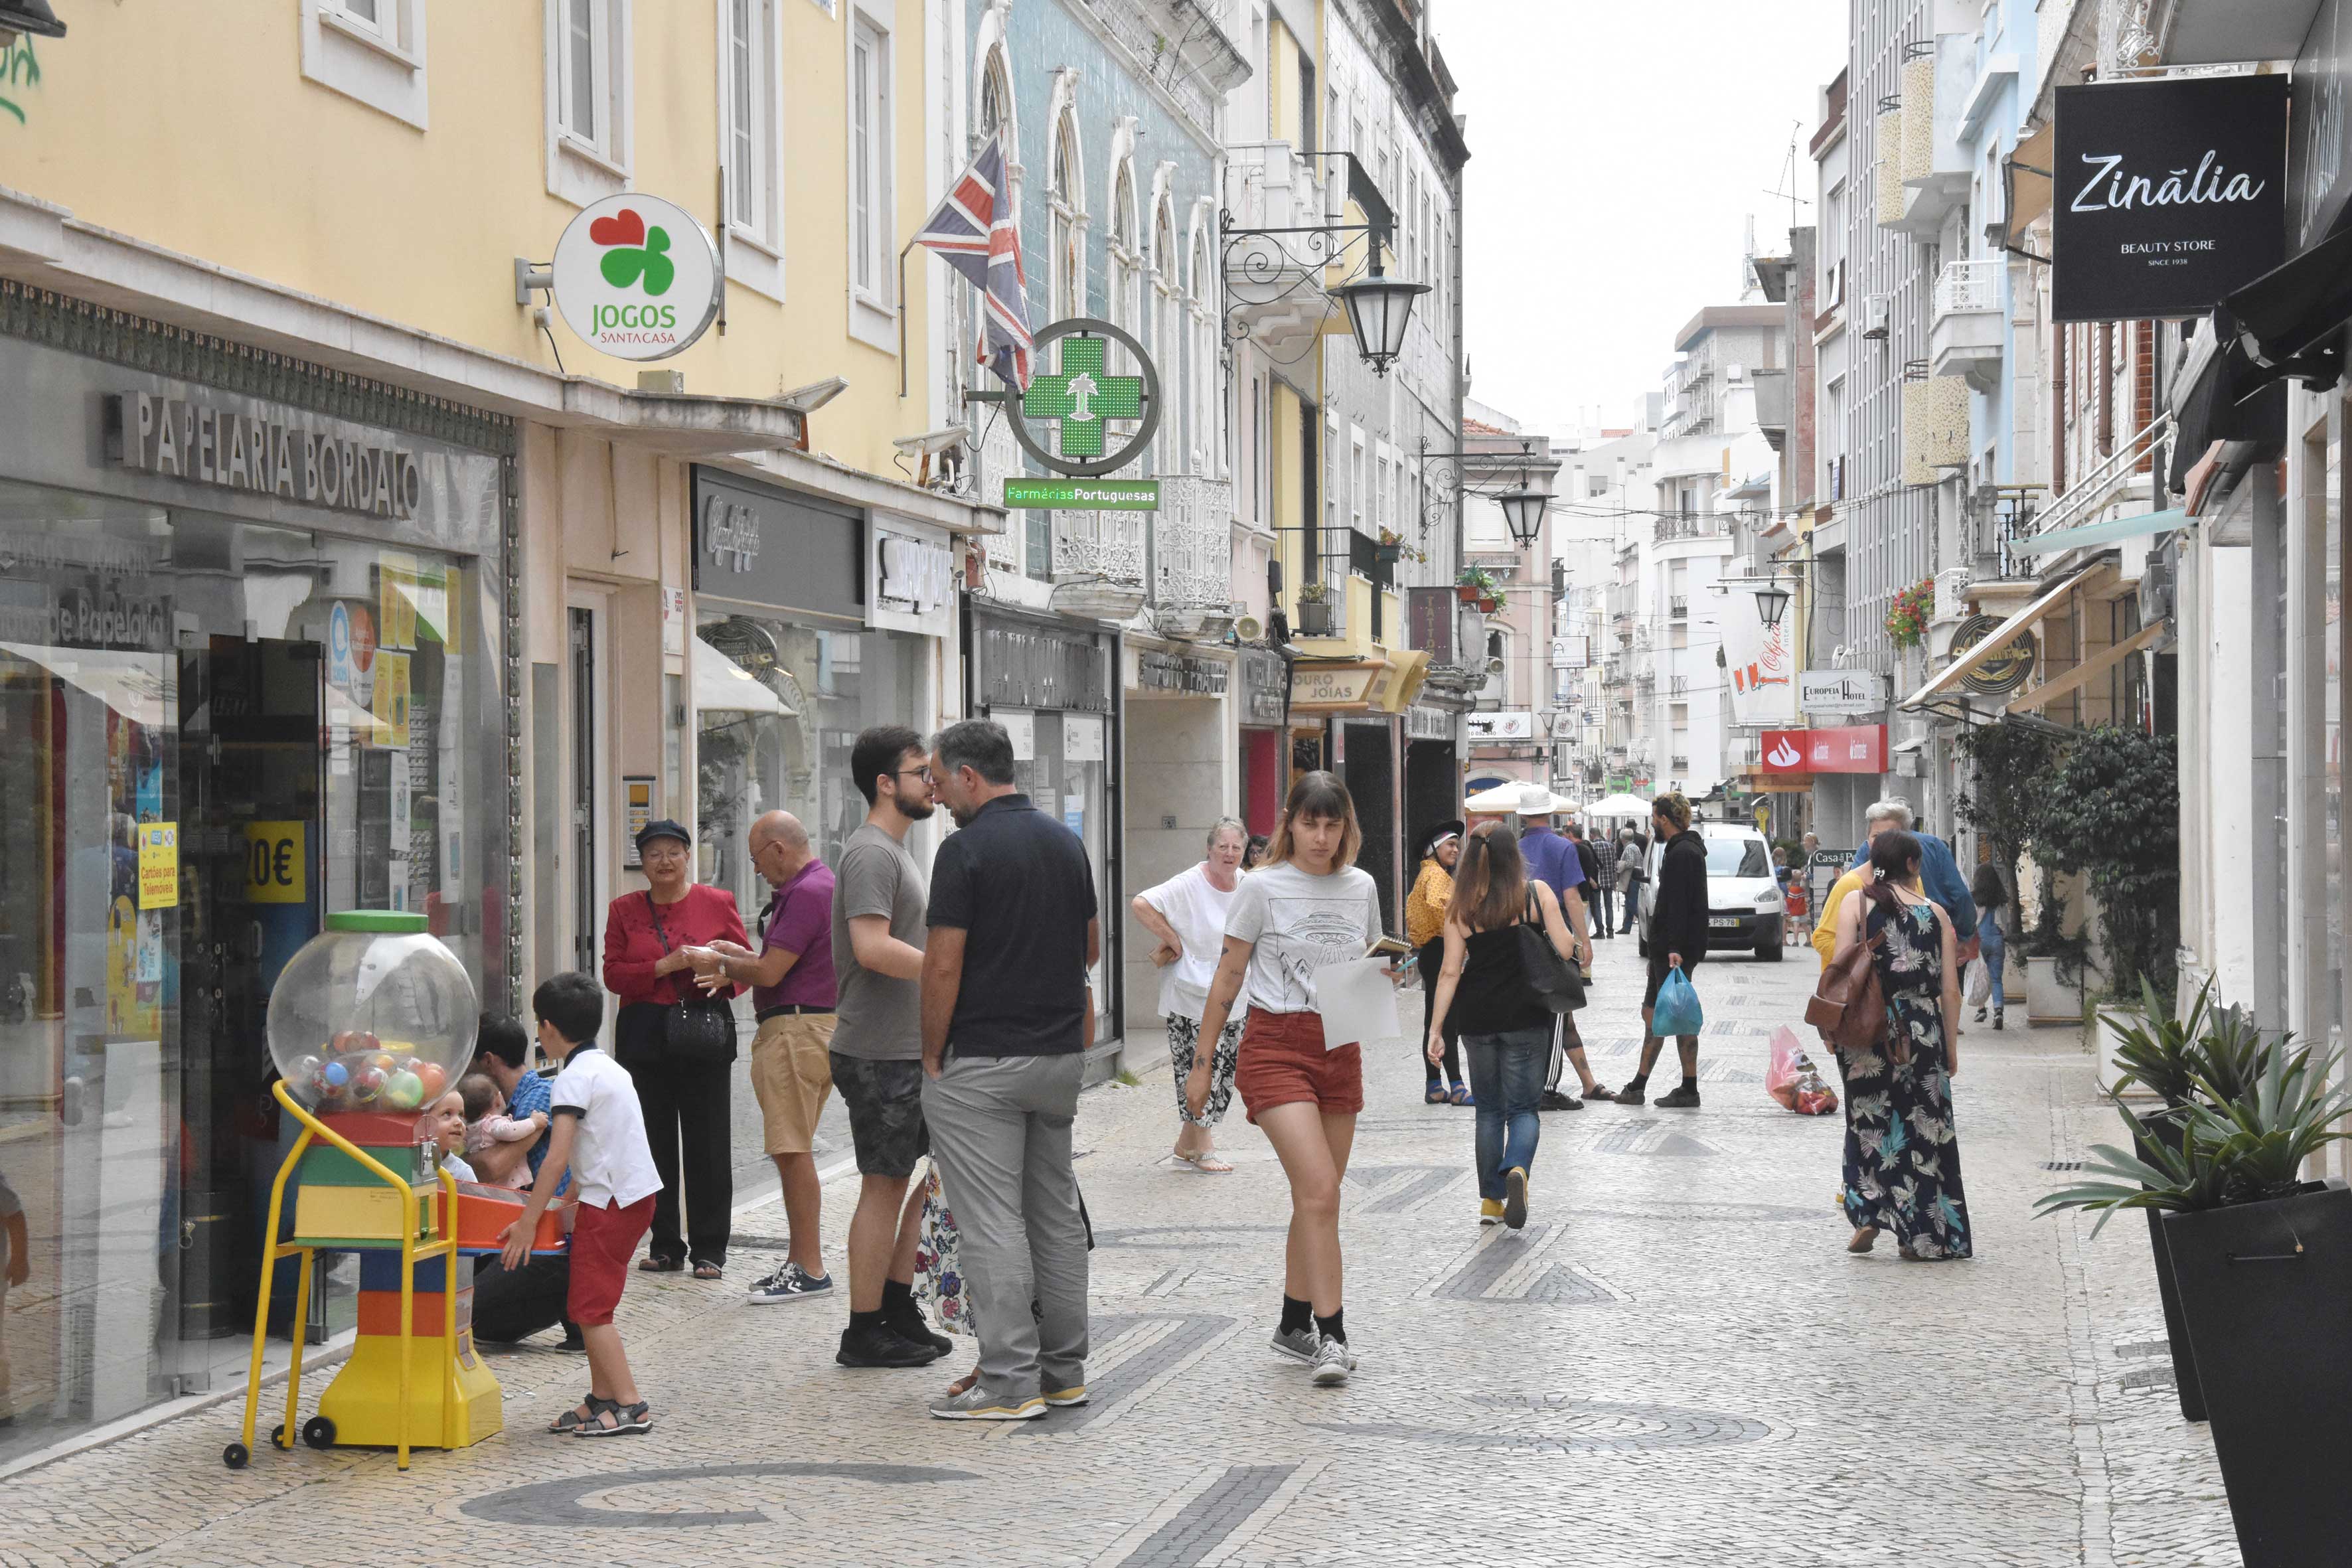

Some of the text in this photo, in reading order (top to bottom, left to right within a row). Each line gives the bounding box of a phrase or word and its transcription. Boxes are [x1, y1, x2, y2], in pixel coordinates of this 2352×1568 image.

[2121, 240, 2216, 254] BEAUTY STORE
[591, 305, 676, 337] JOGOS
[138, 401, 420, 519] PAPELARIA BORDALO
[1294, 673, 1334, 685] OURO
[1311, 687, 1352, 698] JOIAS
[1816, 852, 1838, 862] Casa
[141, 866, 175, 880] Cartões para
[143, 881, 173, 896] Telemóveis
